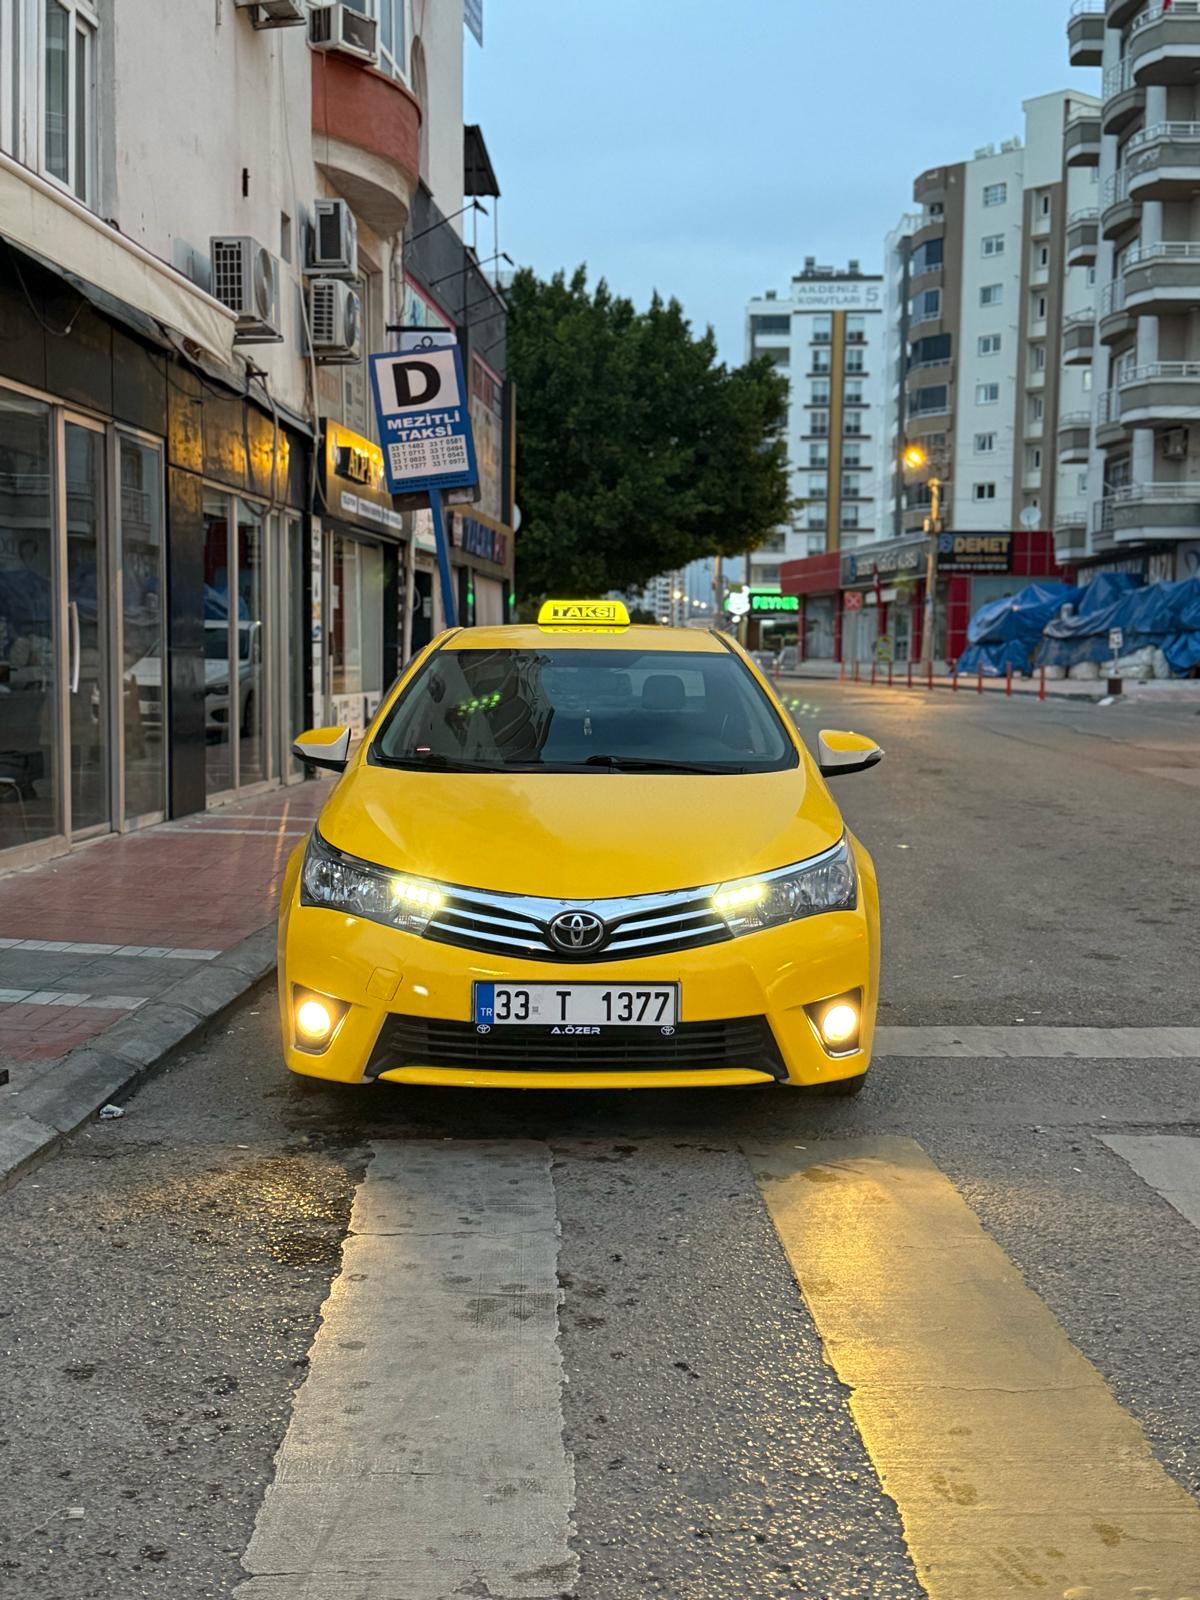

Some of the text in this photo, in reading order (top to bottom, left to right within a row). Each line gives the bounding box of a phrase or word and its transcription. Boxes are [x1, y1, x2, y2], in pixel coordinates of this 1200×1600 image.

[866, 286, 879, 302] 5
[392, 361, 441, 407] D
[386, 410, 460, 430] MEZİTLİ
[398, 424, 452, 442] TAKSİ
[480, 1008, 492, 1016] TR
[496, 990, 670, 1022] 33 T 1377
[550, 1024, 600, 1034] A.ÖZER
